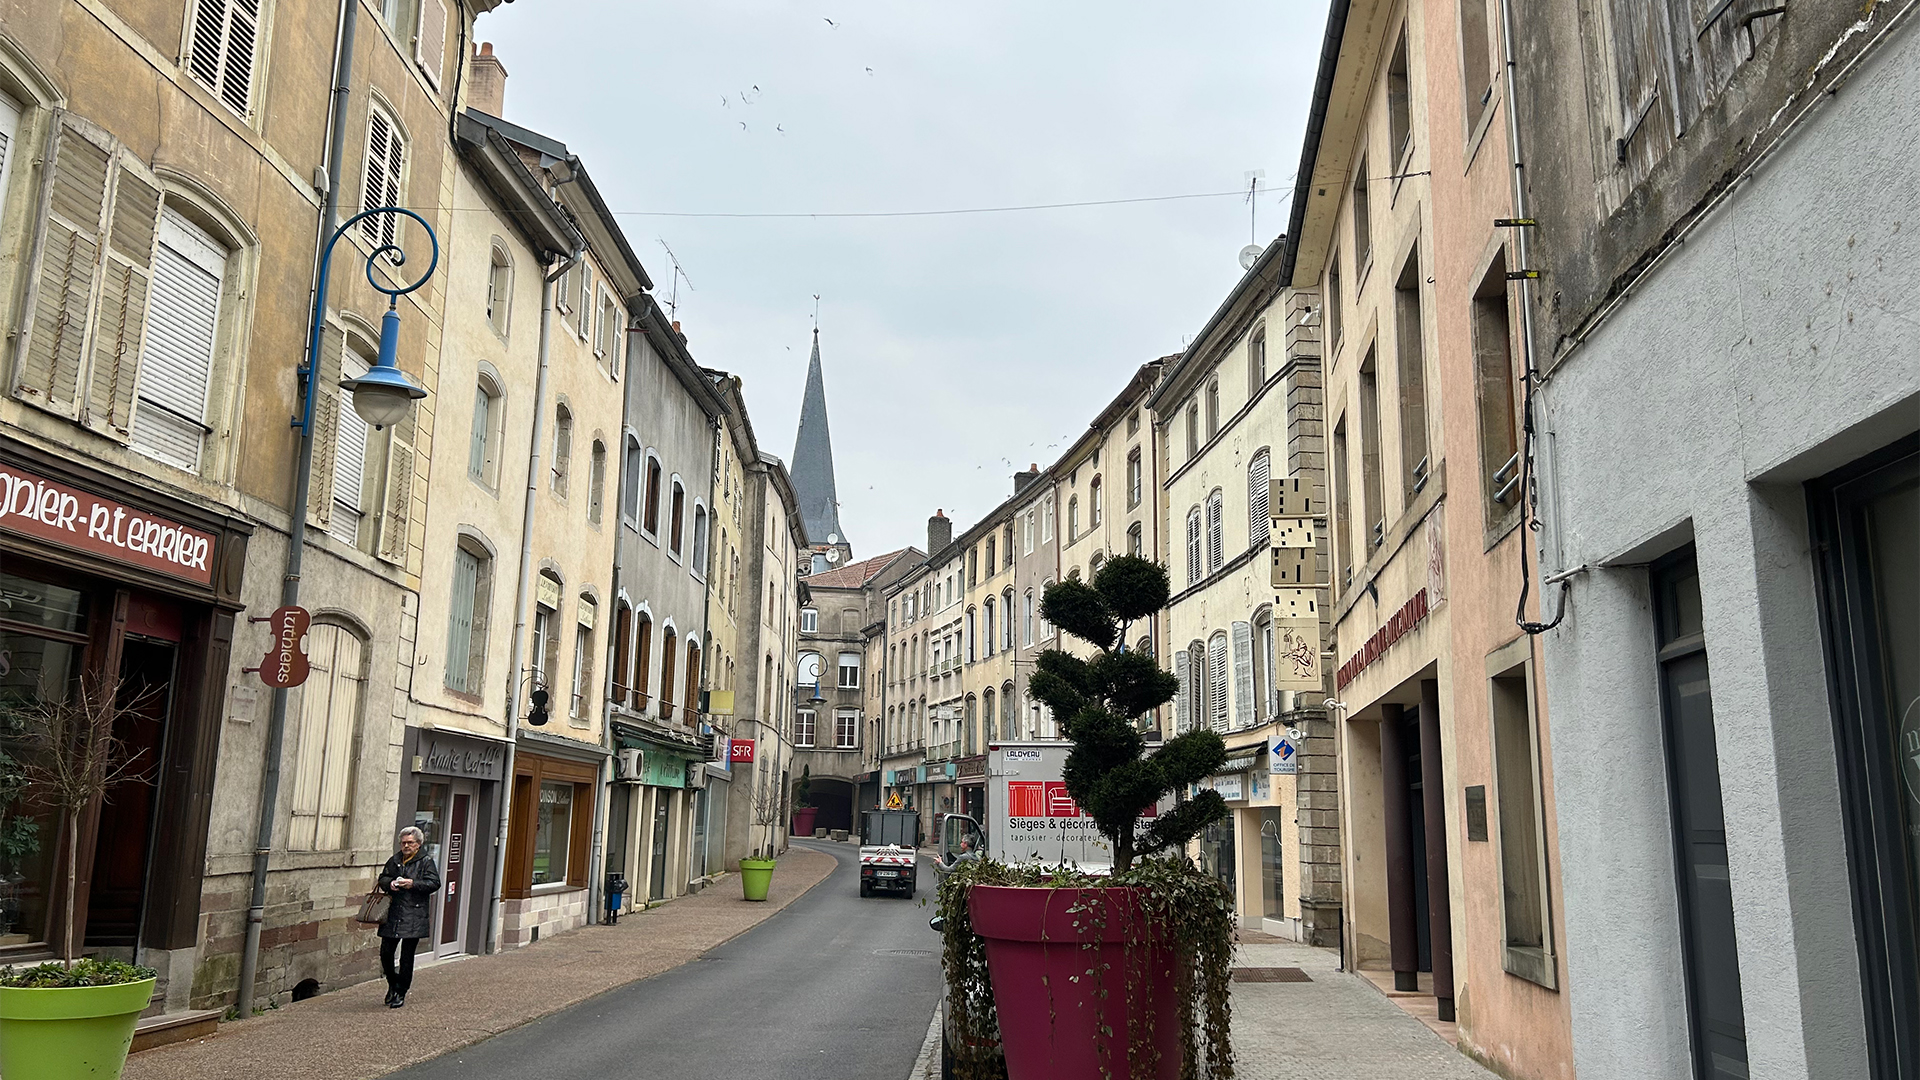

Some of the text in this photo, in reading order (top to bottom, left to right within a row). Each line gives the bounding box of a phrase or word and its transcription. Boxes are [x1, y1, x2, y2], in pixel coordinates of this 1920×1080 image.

[427, 741, 461, 771] Annie
[732, 745, 751, 757] SFR
[1009, 818, 1046, 831] Sièges
[1048, 818, 1057, 829] &
[1011, 834, 1047, 842] tapissier
